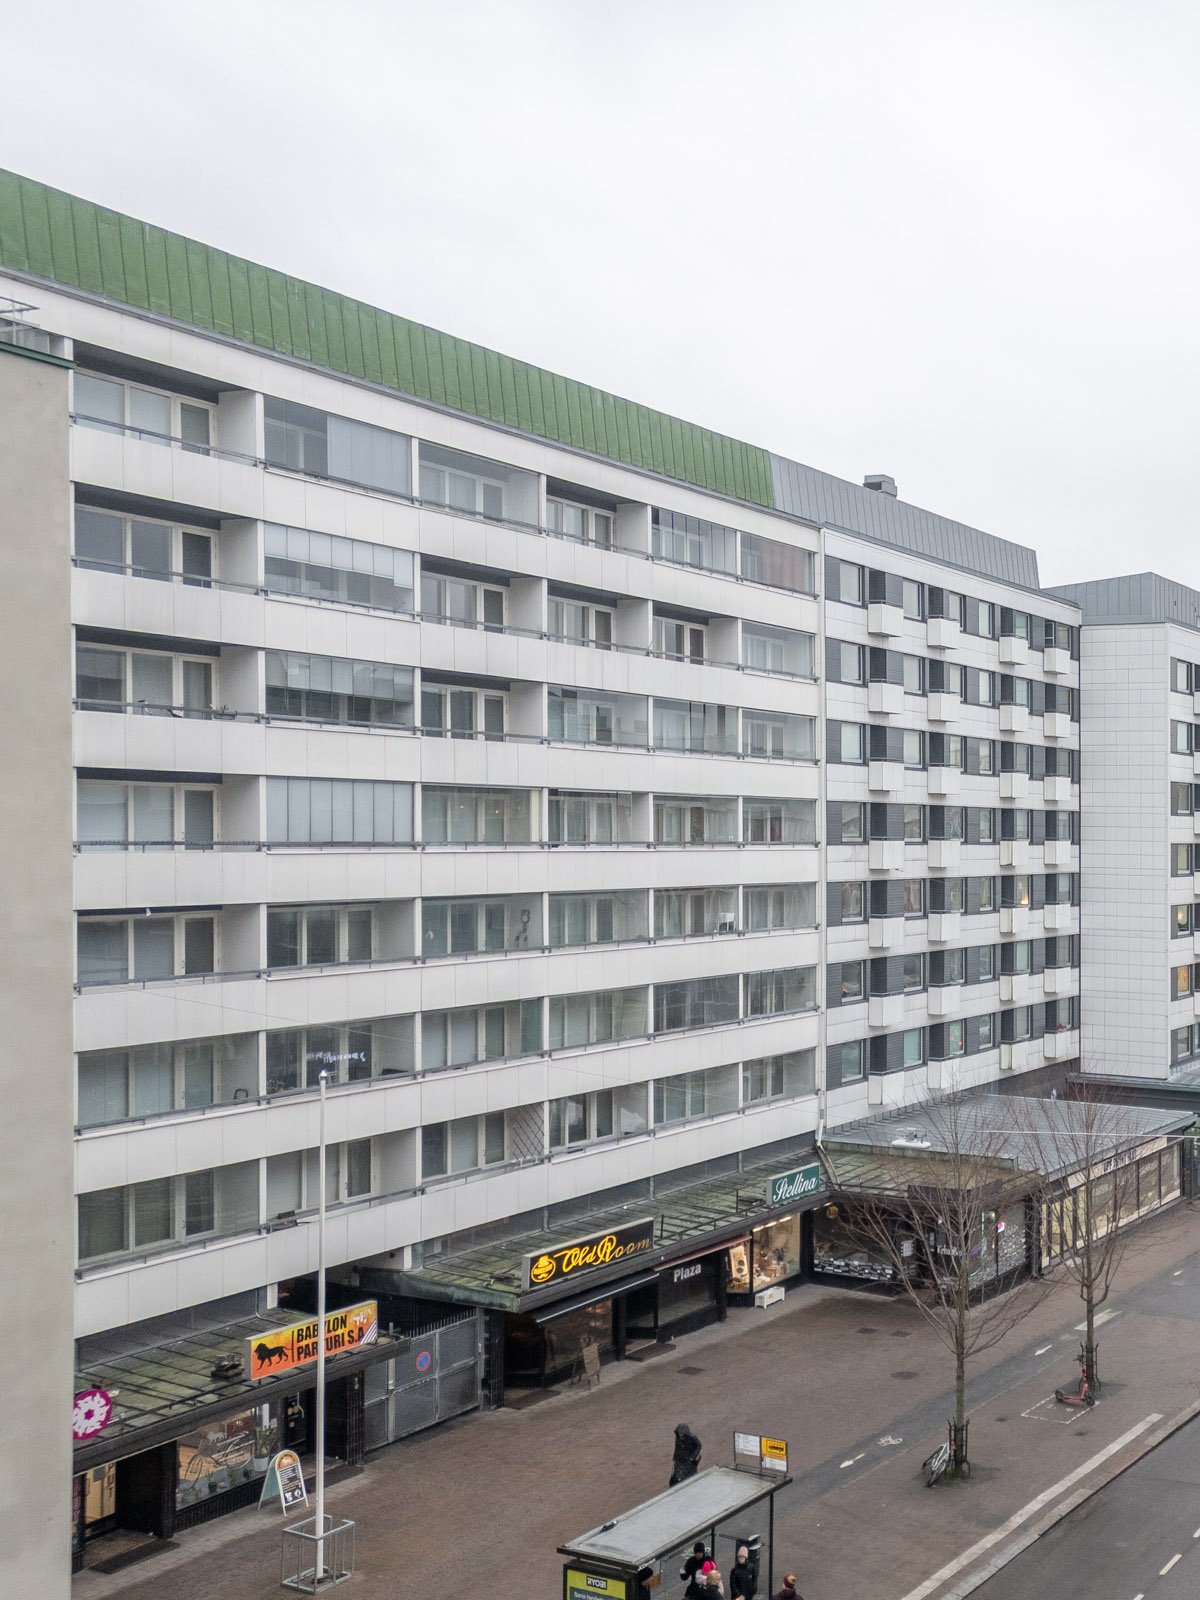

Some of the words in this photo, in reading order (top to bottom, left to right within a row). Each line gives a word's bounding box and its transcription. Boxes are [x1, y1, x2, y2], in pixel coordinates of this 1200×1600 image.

[773, 1172, 818, 1202] Stellina
[553, 1246, 597, 1273] Old
[593, 1235, 650, 1265] Room
[673, 1263, 702, 1283] Plaza
[297, 1332, 344, 1362] PARURI
[587, 1577, 606, 1589] RYOBI
